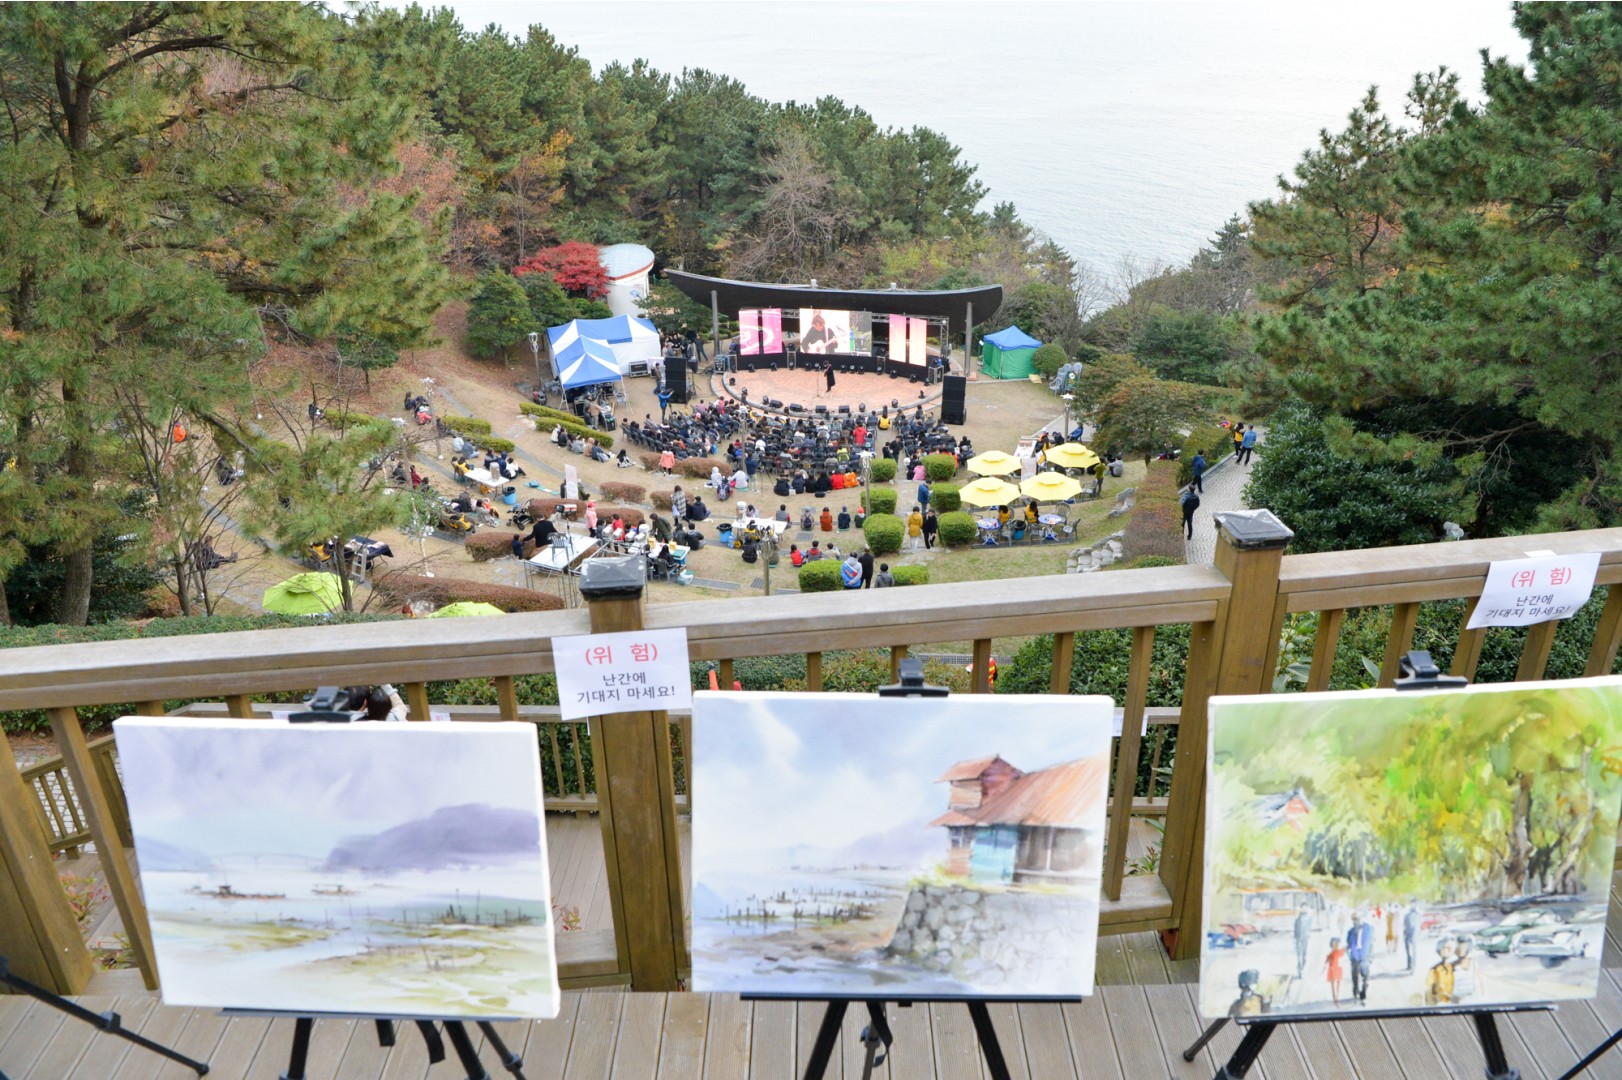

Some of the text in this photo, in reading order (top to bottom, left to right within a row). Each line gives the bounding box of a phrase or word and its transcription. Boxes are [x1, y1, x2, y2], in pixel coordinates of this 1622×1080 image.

[1511, 567, 1572, 588] (위 험)
[1516, 594, 1554, 606] 난간에
[1486, 605, 1570, 618] 기대지 마세요!
[585, 643, 658, 665] (위 험)
[603, 671, 647, 687] 난간에
[577, 685, 675, 704] 기대지 마세요!
